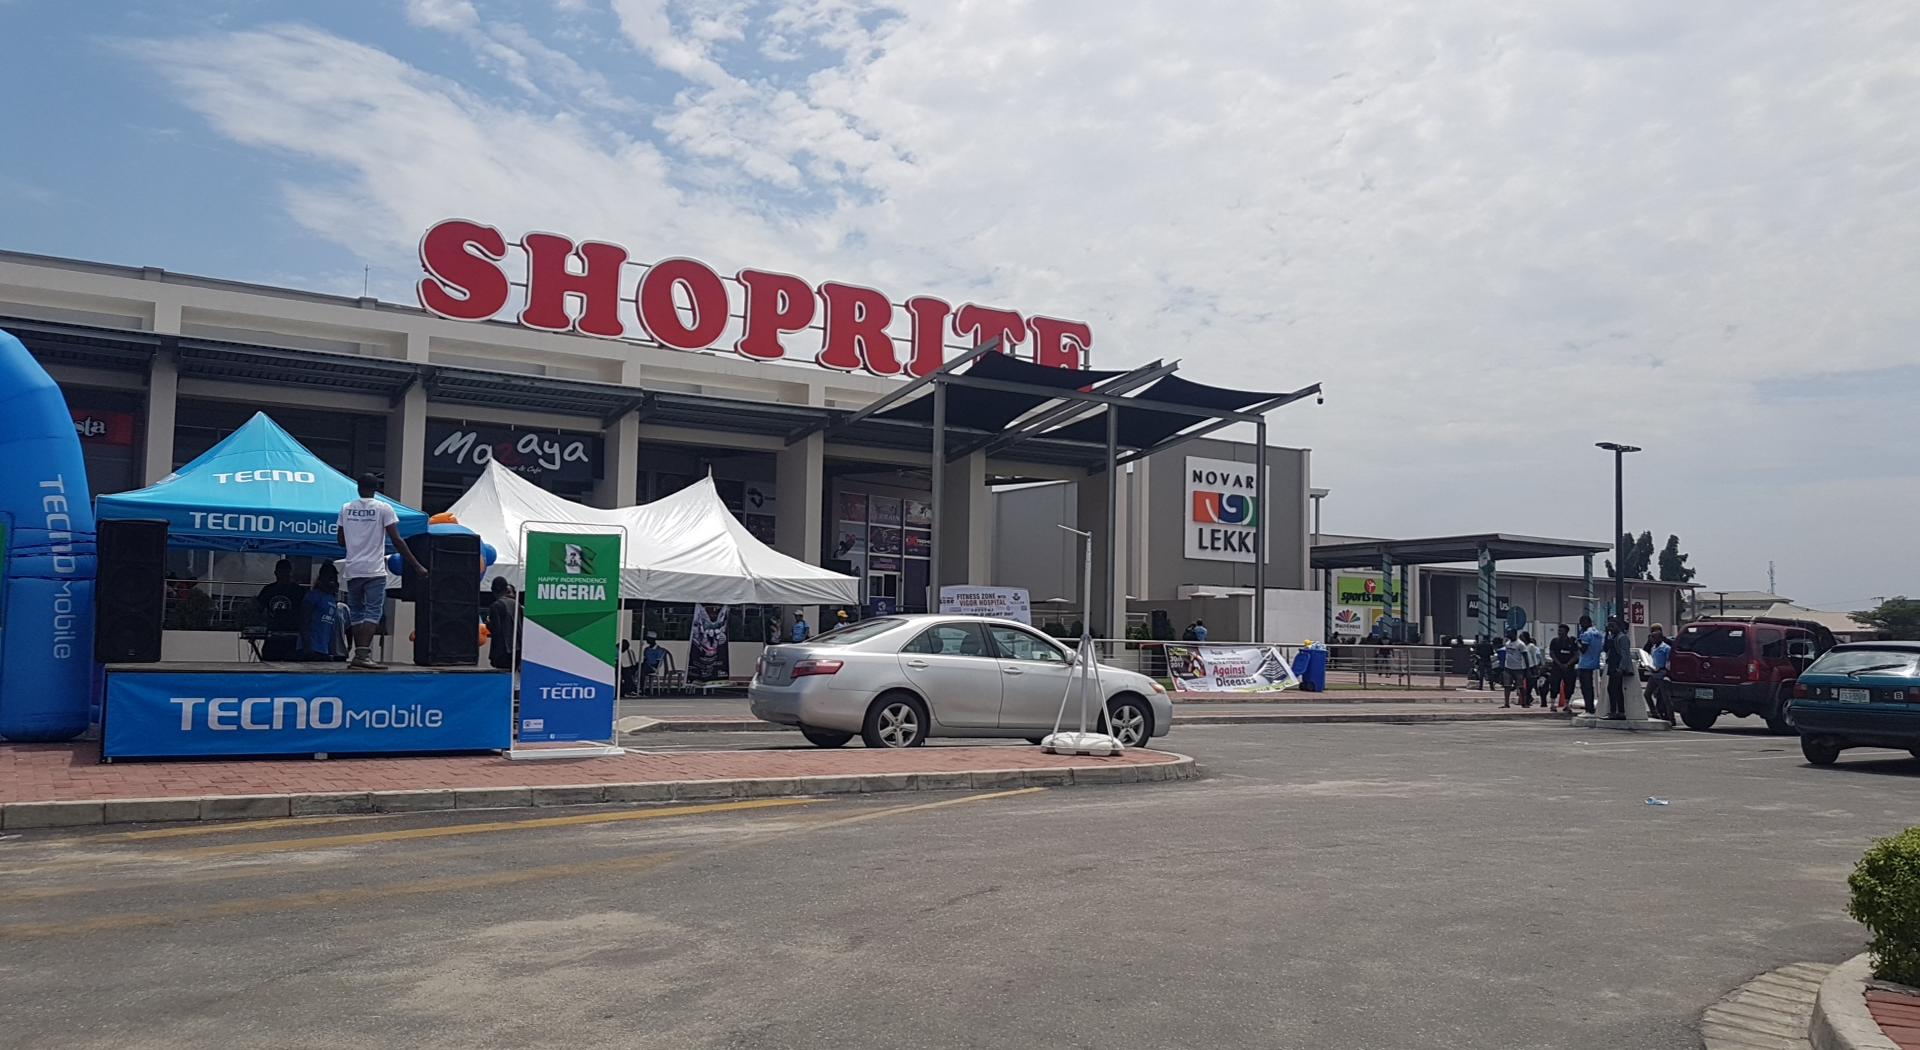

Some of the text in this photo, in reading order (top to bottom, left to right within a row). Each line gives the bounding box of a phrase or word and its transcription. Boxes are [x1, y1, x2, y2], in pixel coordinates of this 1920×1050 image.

[416, 217, 1094, 386] SHOPRITE
[74, 417, 106, 437] sta
[434, 431, 589, 470] Mazaya
[212, 469, 315, 484] TECNO
[1192, 470, 1255, 489] NOVAR
[189, 511, 275, 532] TECNO
[345, 508, 376, 517] TECNO
[39, 474, 76, 574] TECNO
[537, 583, 606, 601] NIGERIA
[979, 599, 1007, 607] HOSPITAL
[1213, 665, 1246, 677] Against
[1216, 677, 1257, 687] Diseases
[539, 686, 596, 699] TECNO
[170, 697, 343, 731] TECNO
